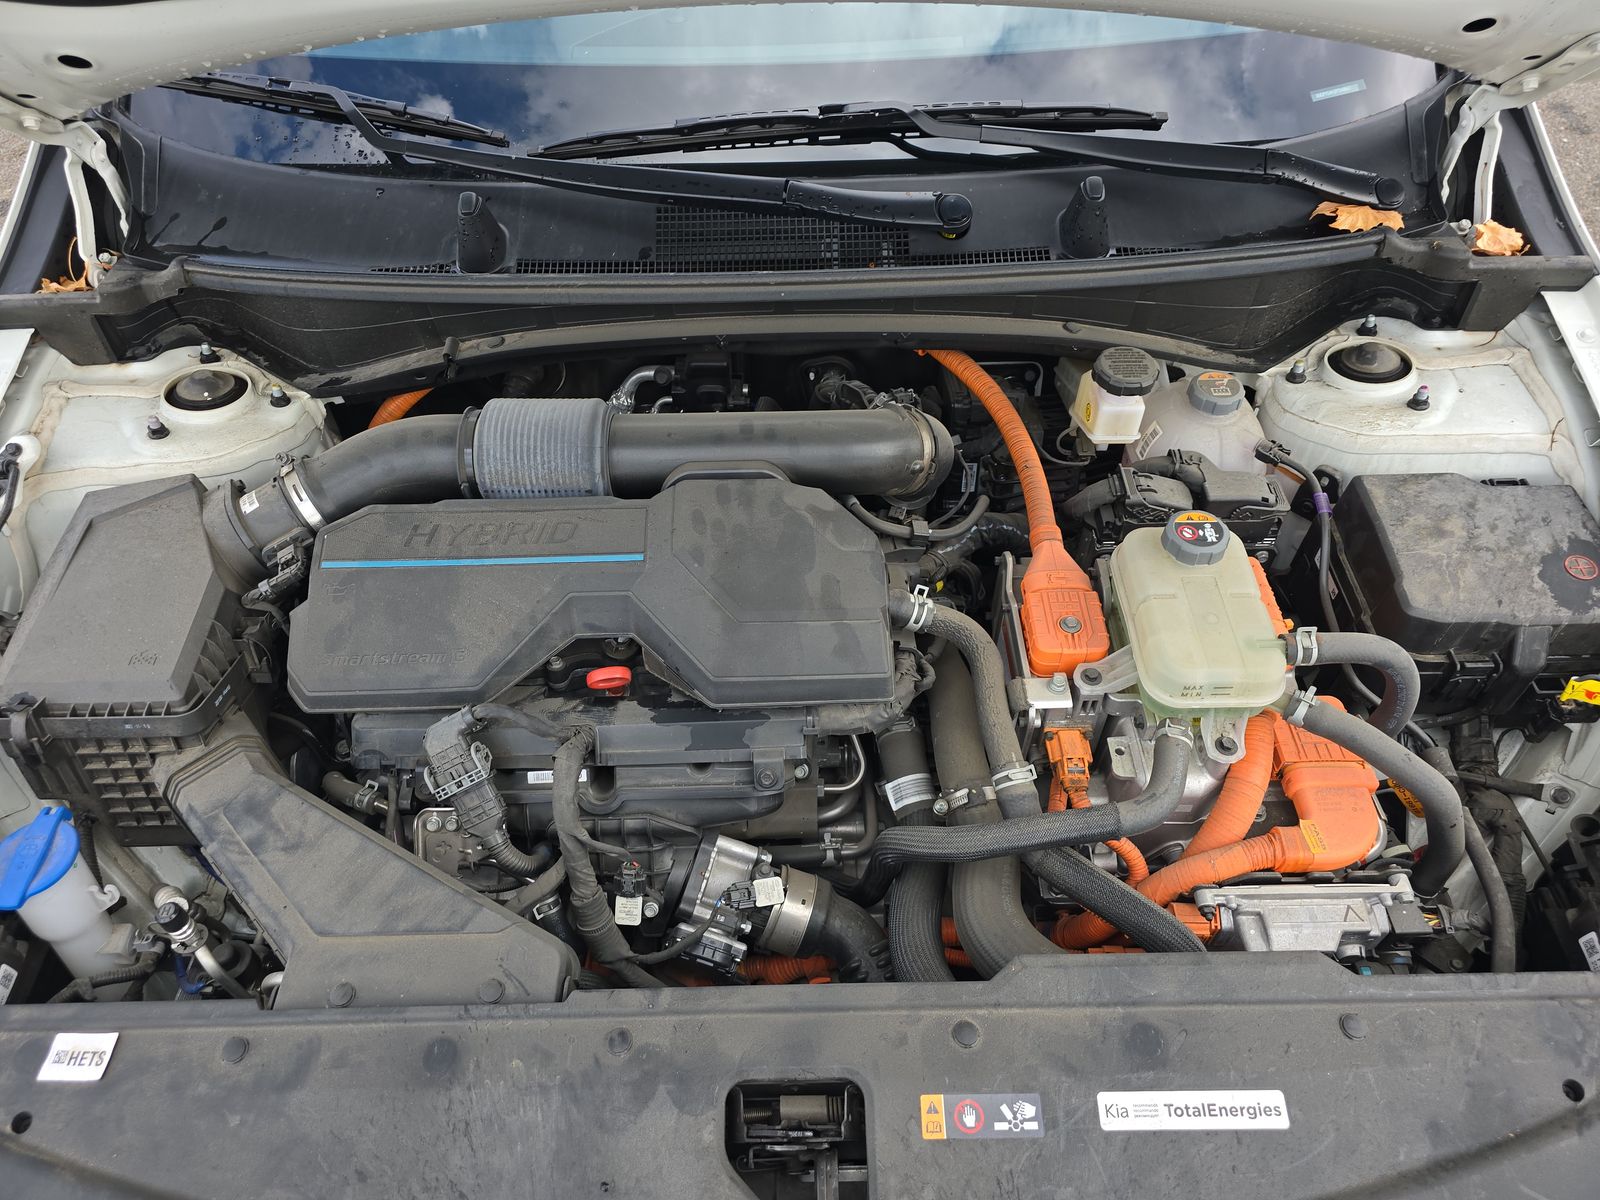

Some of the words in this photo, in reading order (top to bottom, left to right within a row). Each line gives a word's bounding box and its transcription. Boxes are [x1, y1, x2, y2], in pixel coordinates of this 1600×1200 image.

[403, 520, 578, 548] HYBRID
[321, 651, 447, 666] Smartstream
[66, 1050, 107, 1067] HETS
[1104, 1103, 1130, 1119] Kia
[1163, 1102, 1283, 1120] TotalEnergies
